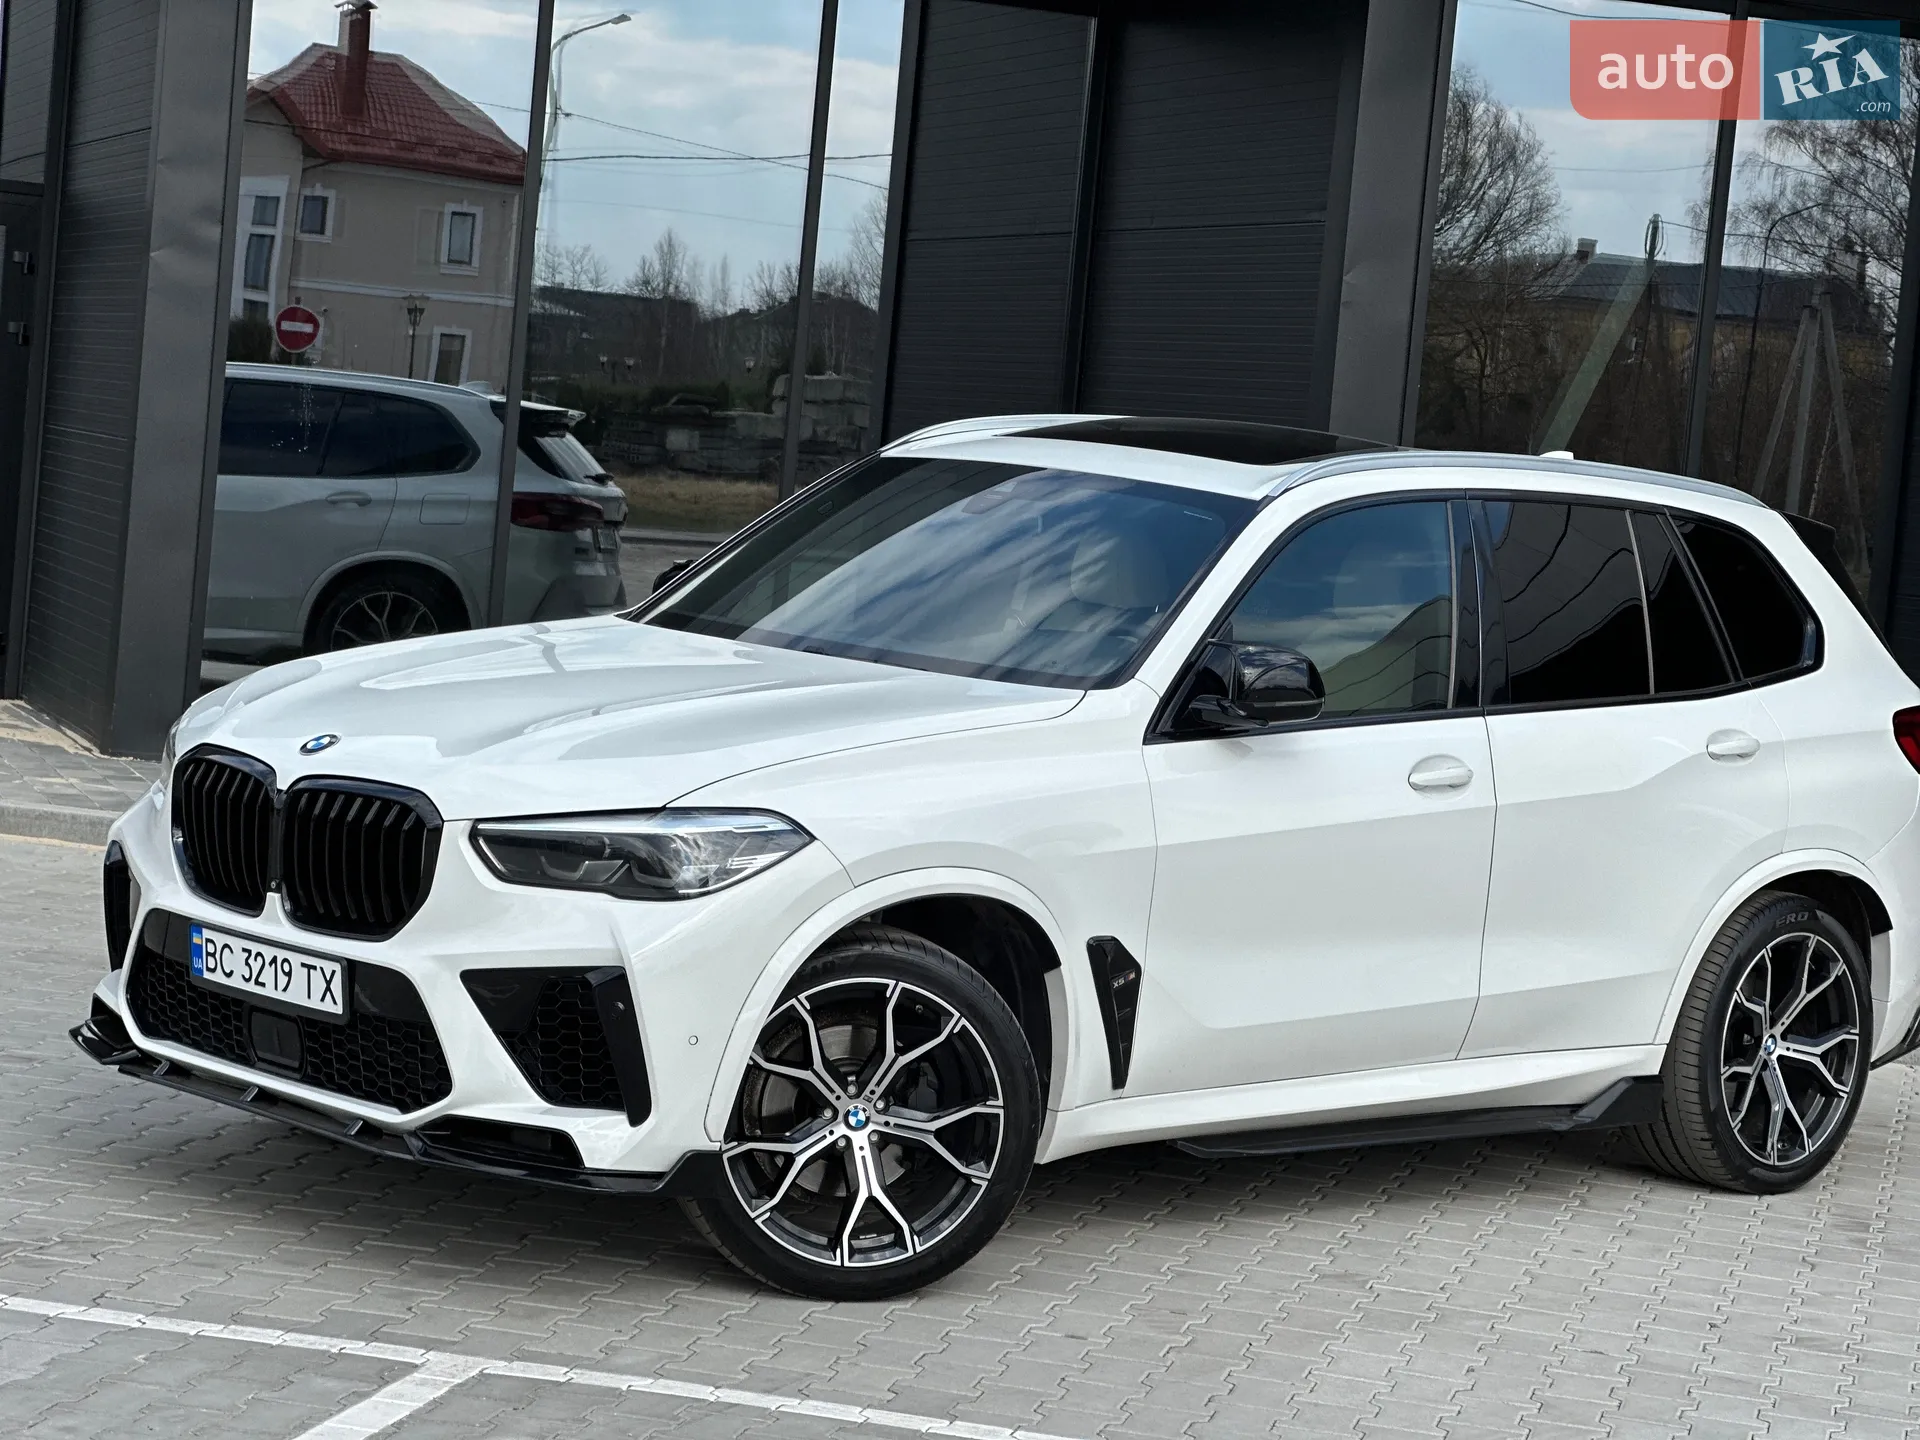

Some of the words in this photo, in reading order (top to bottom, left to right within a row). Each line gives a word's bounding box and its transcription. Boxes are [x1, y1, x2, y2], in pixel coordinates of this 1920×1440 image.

[193, 956, 203, 970] UA
[205, 937, 234, 978] BC
[241, 947, 293, 993] 3219
[300, 962, 338, 1006] TX
